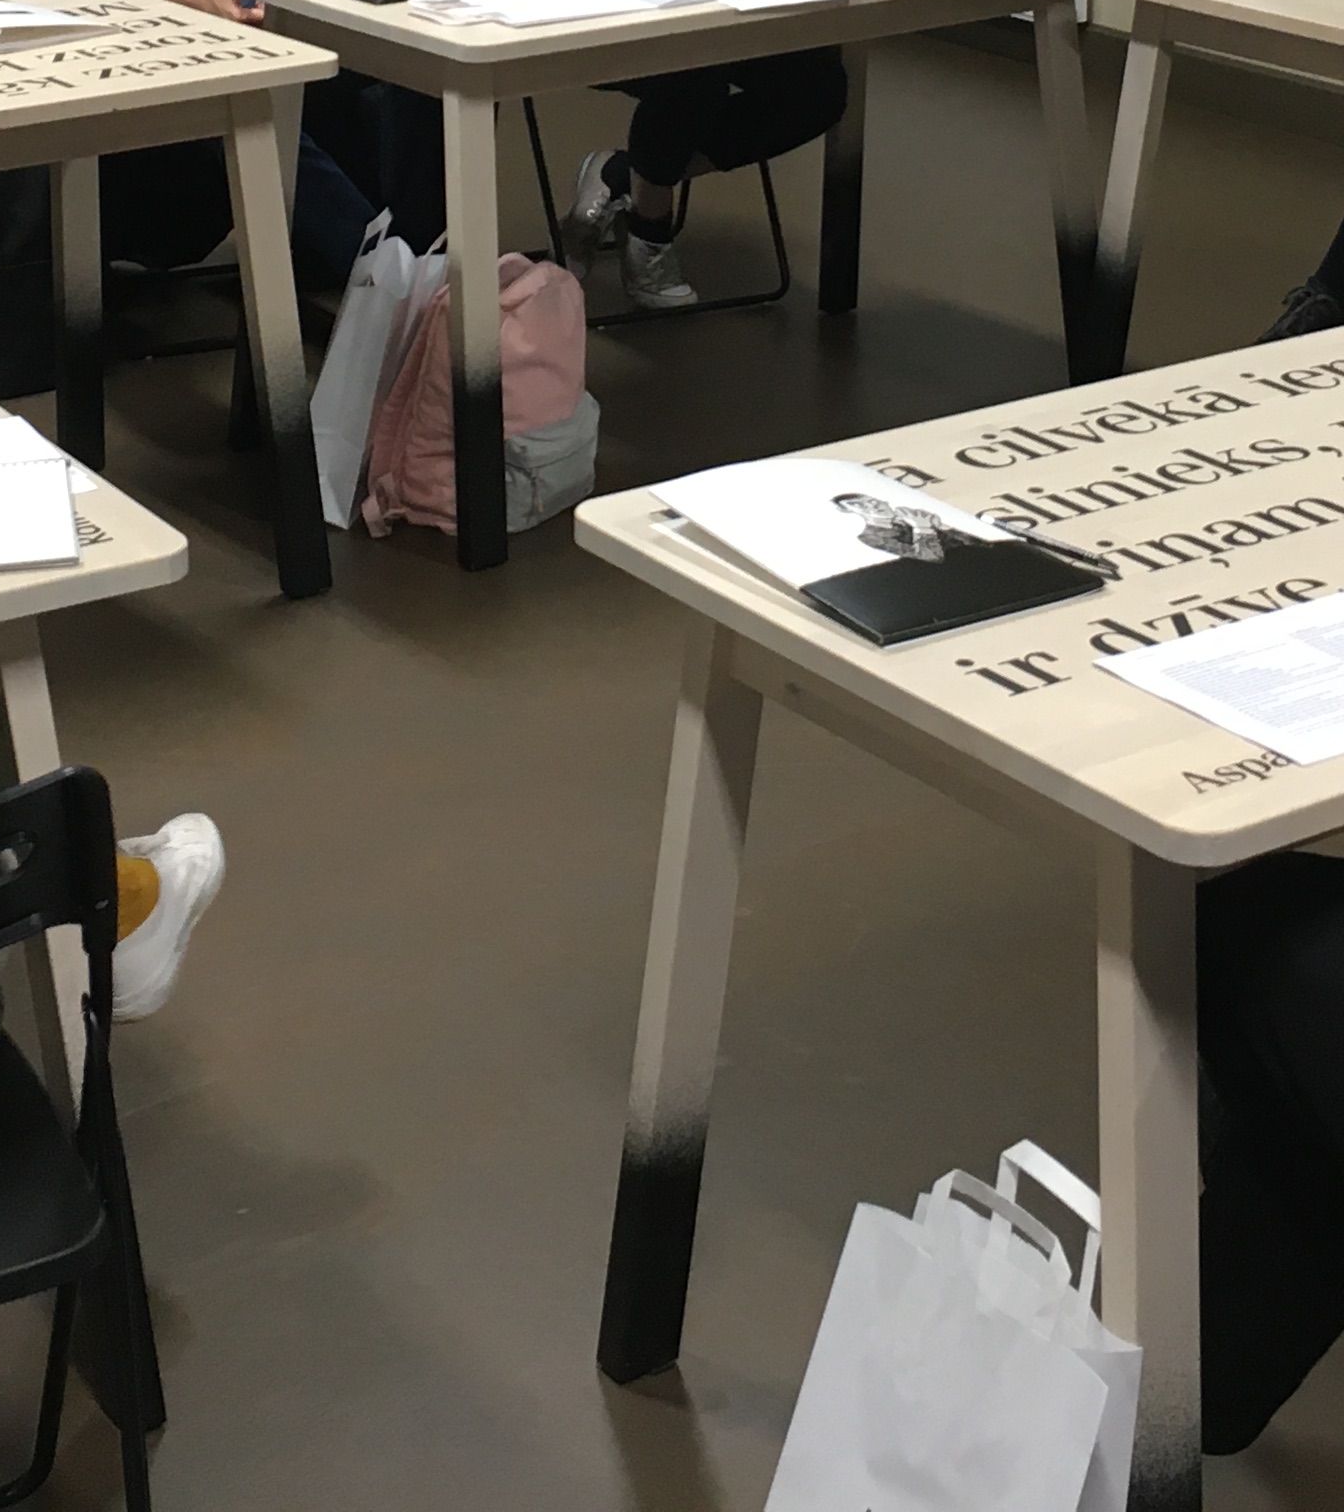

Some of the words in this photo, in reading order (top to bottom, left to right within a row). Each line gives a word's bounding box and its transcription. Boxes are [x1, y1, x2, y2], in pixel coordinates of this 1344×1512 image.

[36, 29, 247, 63] Toreiz
[82, 45, 295, 80] Toreiz
[954, 384, 1260, 469] cilvēkā
[976, 439, 1342, 531] slinieks,
[955, 651, 1072, 697] ir
[1182, 748, 1295, 794] Aspa
